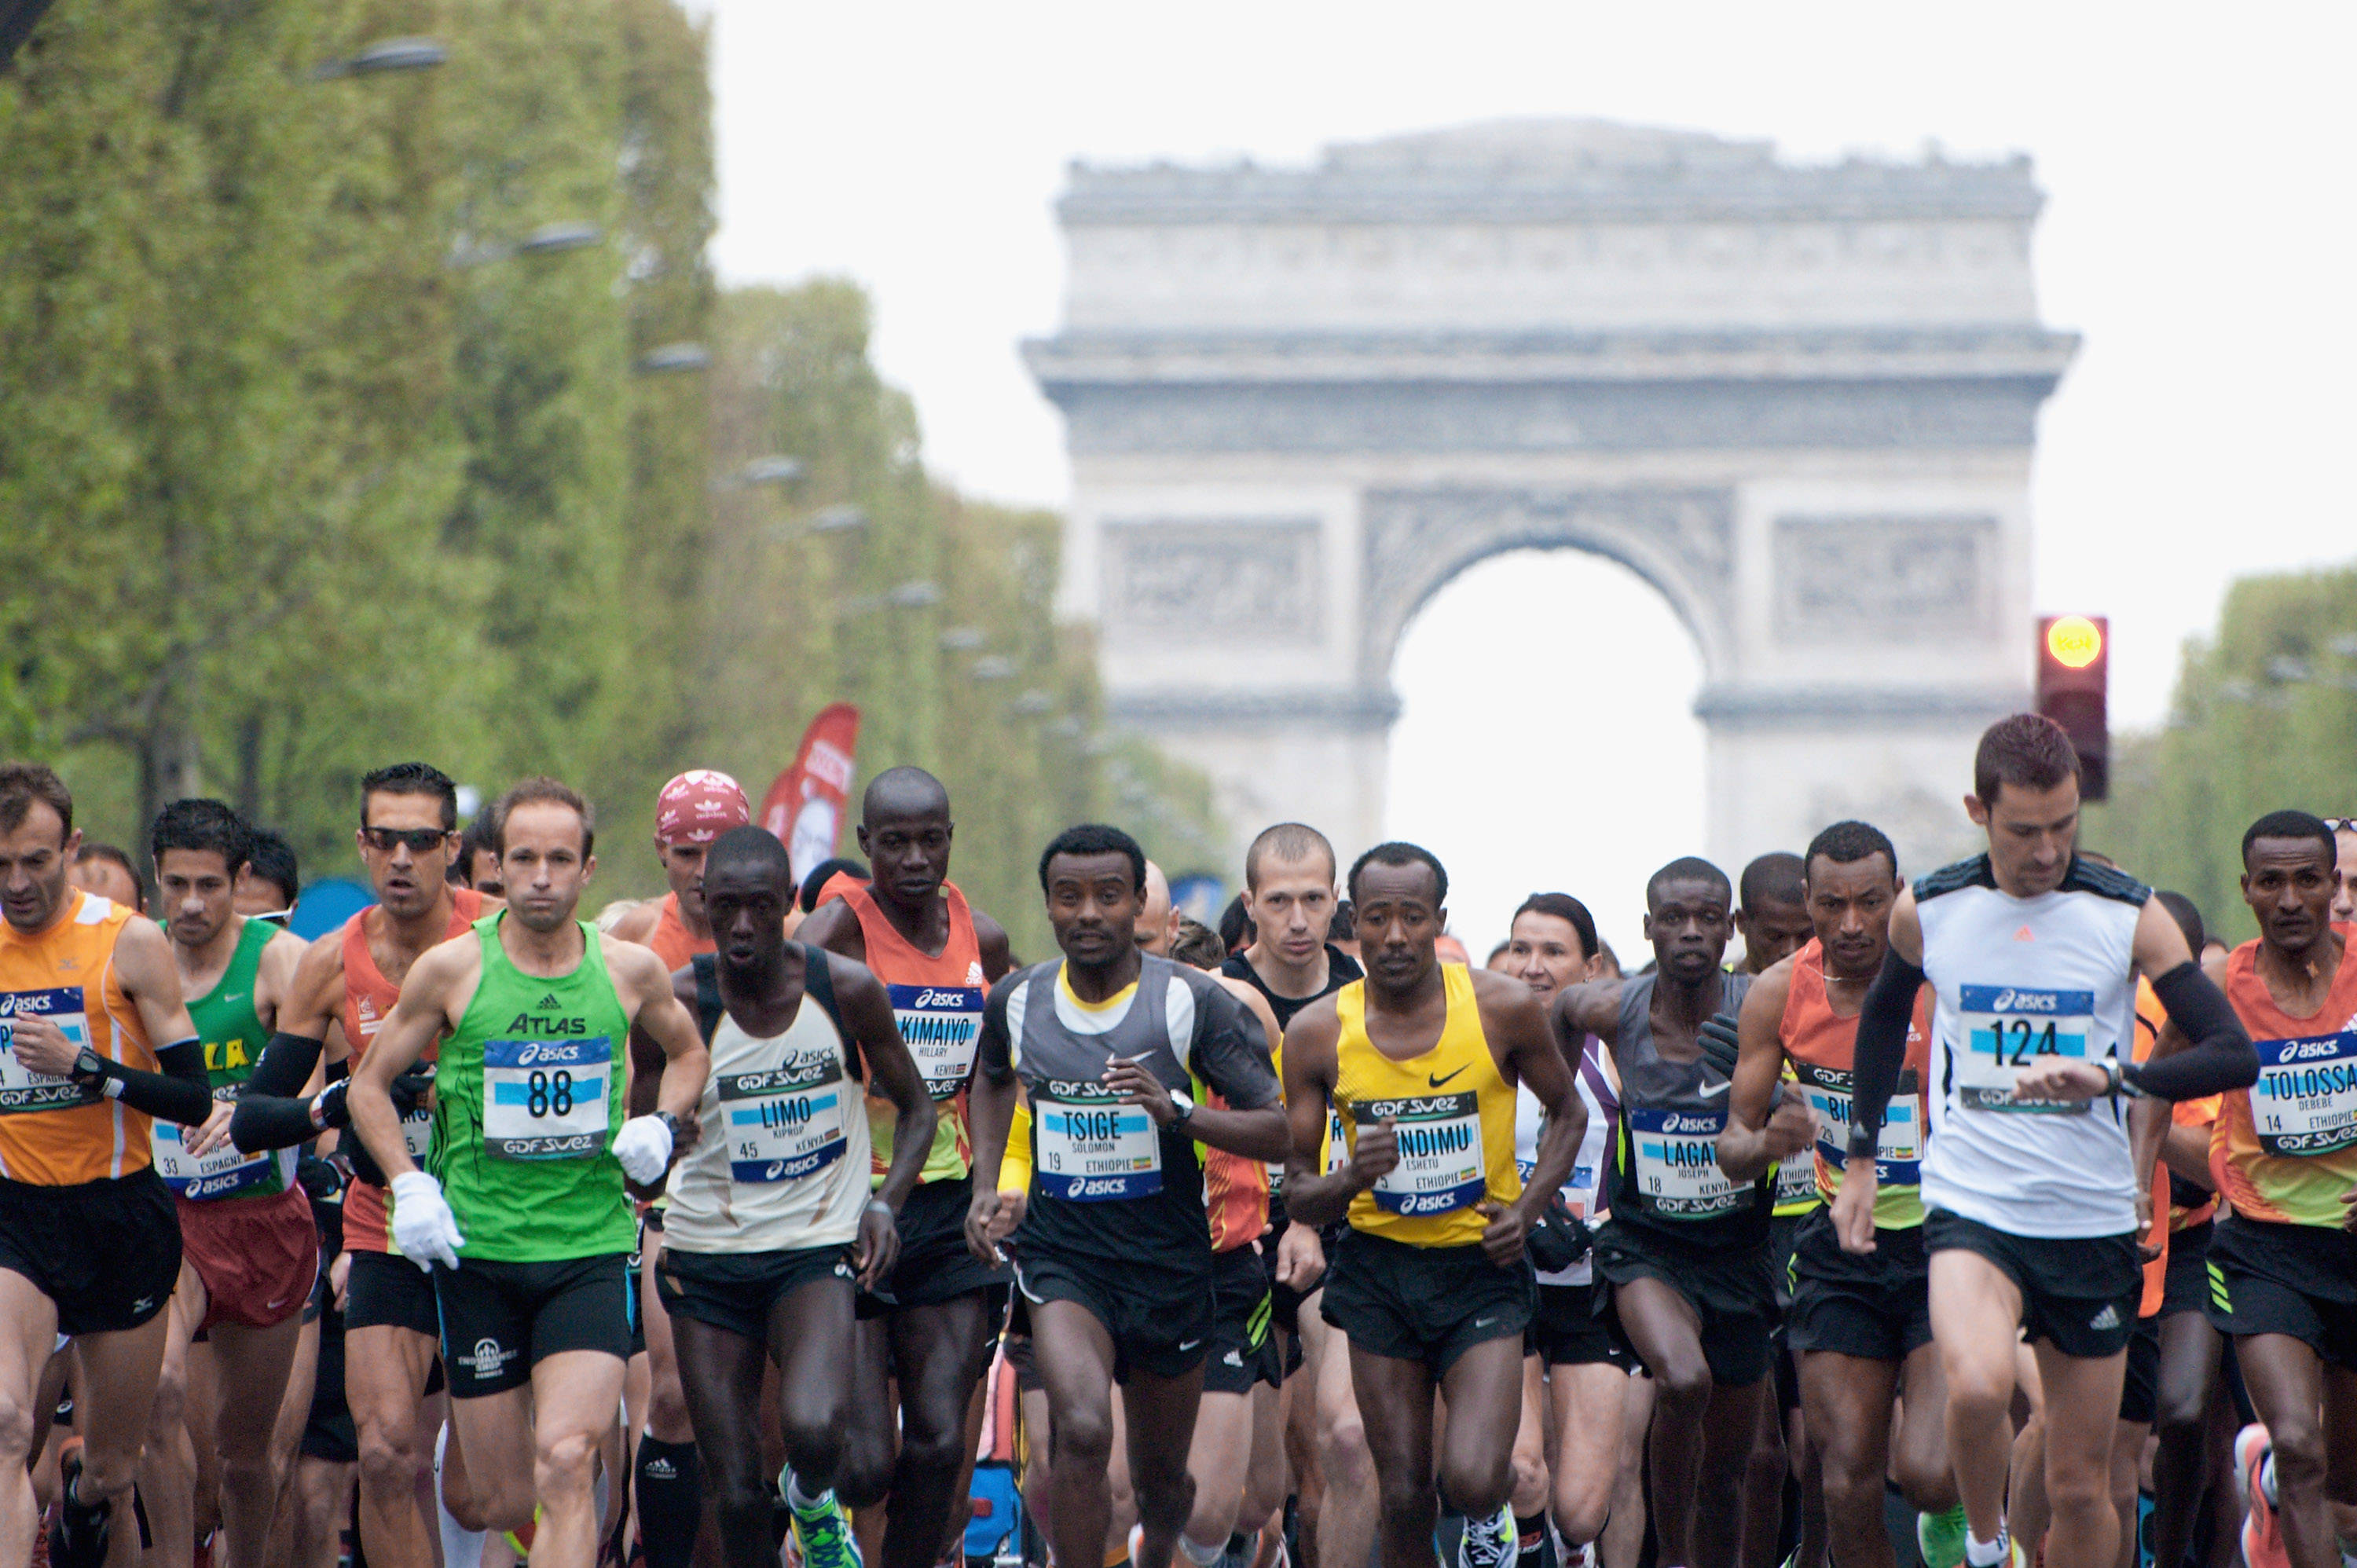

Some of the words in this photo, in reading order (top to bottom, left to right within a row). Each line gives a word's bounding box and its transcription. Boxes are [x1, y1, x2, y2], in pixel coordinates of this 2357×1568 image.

[14, 995, 51, 1012] asics
[931, 993, 965, 1007] asics
[2014, 993, 2057, 1012] asics
[506, 1013, 586, 1035] ATLAS
[901, 1016, 969, 1046] KIMAIYO
[1990, 1019, 2060, 1067] 124
[2298, 1039, 2338, 1058] asics
[538, 1046, 580, 1061] asics
[800, 1046, 834, 1063] asics
[918, 1046, 948, 1058] HILLARY
[934, 1064, 956, 1076] KENYA
[1813, 1068, 1846, 1085] GDF
[737, 1072, 773, 1091] GDF
[1049, 1079, 1082, 1097] GDF
[2266, 1063, 2357, 1101] TOLOSSA
[1, 1090, 30, 1106] GDF
[528, 1070, 573, 1118] 88
[761, 1097, 811, 1128] LIMO
[1371, 1101, 1407, 1117] GDF
[2298, 1096, 2333, 1112] DEBEBE
[1063, 1112, 1121, 1140] TSIGE
[1679, 1117, 1717, 1132] asics
[2265, 1114, 2282, 1132] 14
[2309, 1111, 2354, 1130] ETHIOPIE
[772, 1126, 805, 1139] KIPROP
[1400, 1123, 1469, 1158] NDIMU
[503, 1139, 539, 1153] GDF
[740, 1141, 758, 1158] 45
[795, 1134, 824, 1154] KENYA
[1072, 1142, 1116, 1154] SOLOMON
[2277, 1134, 2313, 1150] GDF
[163, 1157, 178, 1174] 33
[200, 1156, 244, 1174] ESPAGNE
[784, 1153, 819, 1176] asics
[1049, 1152, 1061, 1171] 19
[1086, 1158, 1132, 1173] ETHIOPIE
[1406, 1158, 1439, 1171] ESHETU
[1416, 1172, 1460, 1189] ETHIOPIE
[1678, 1169, 1709, 1178] JOSEPH
[202, 1173, 240, 1194] asics
[1085, 1178, 1126, 1196] asics
[1648, 1176, 1662, 1193] 18
[1699, 1181, 1729, 1195] KENYA
[1417, 1192, 1456, 1211] asics
[1655, 1197, 1688, 1213] GDF
